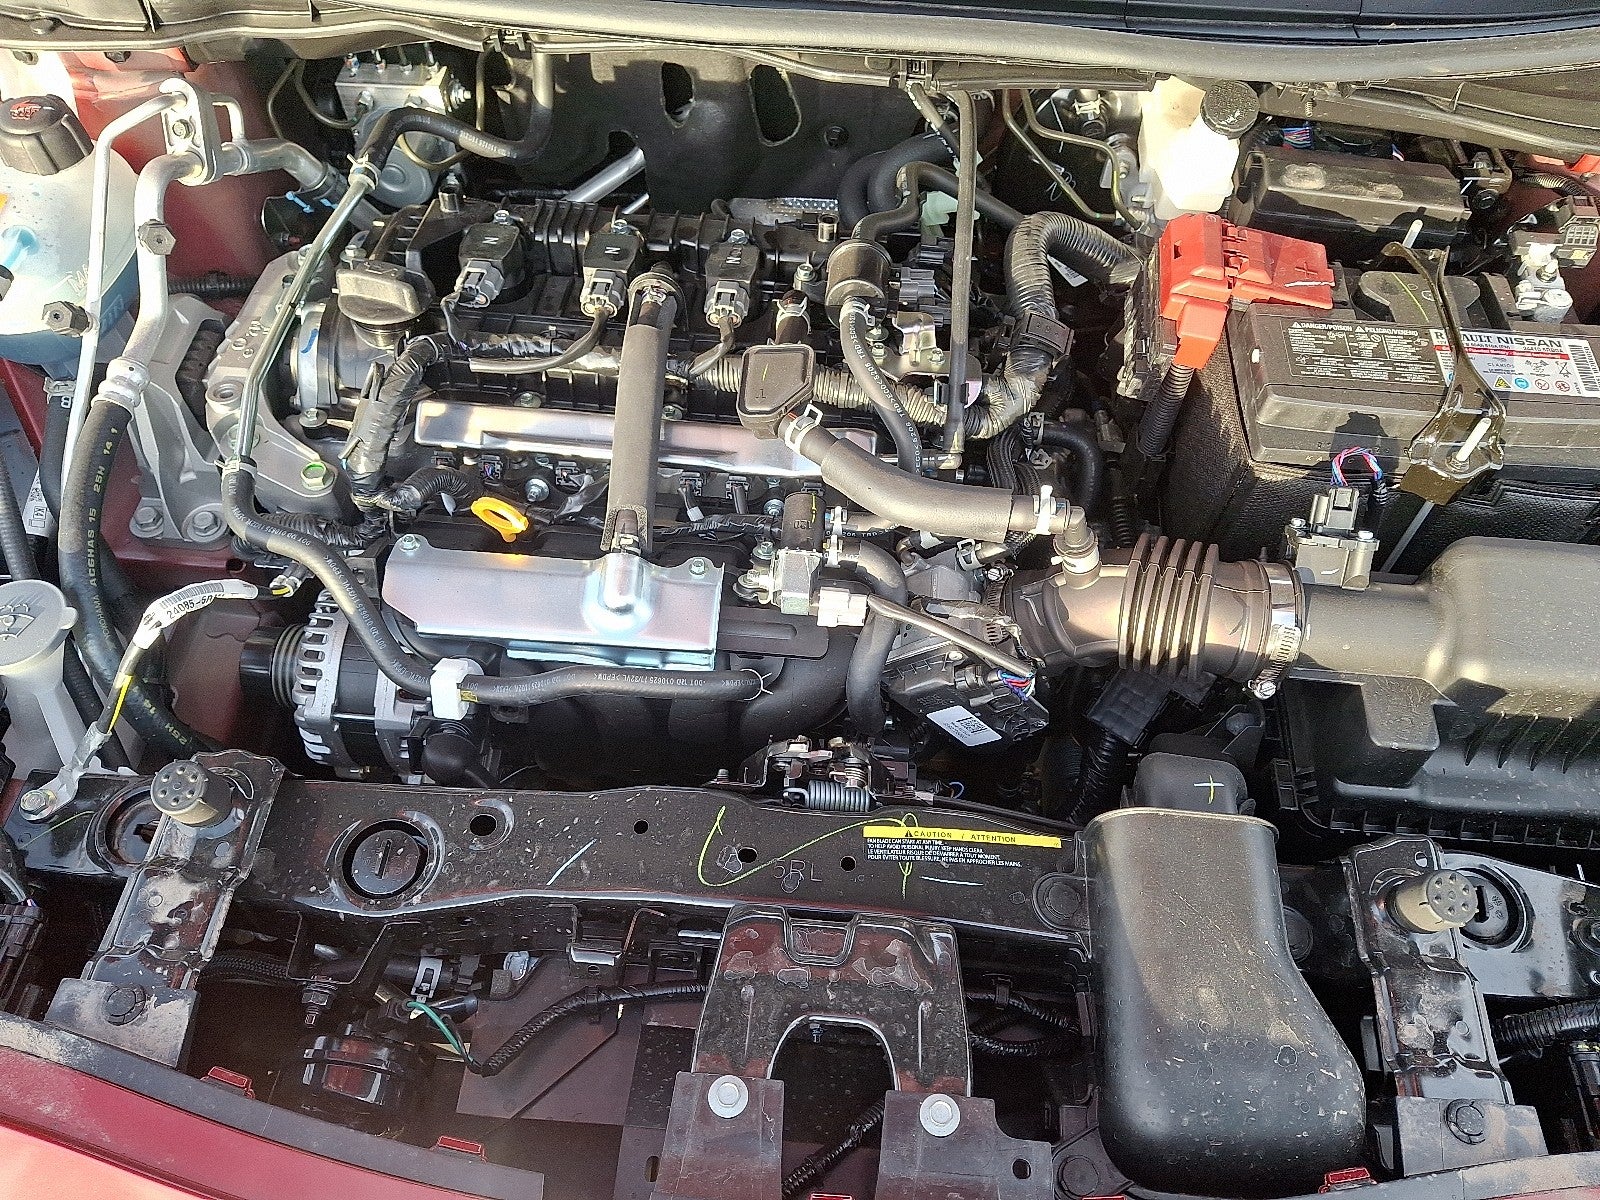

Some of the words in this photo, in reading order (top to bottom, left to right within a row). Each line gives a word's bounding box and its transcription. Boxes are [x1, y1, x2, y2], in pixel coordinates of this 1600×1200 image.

[1434, 331, 1493, 344] RAULT
[1497, 336, 1562, 348] NISSAN
[913, 830, 952, 839] CAUTION
[970, 833, 1016, 843] ATTENTION
